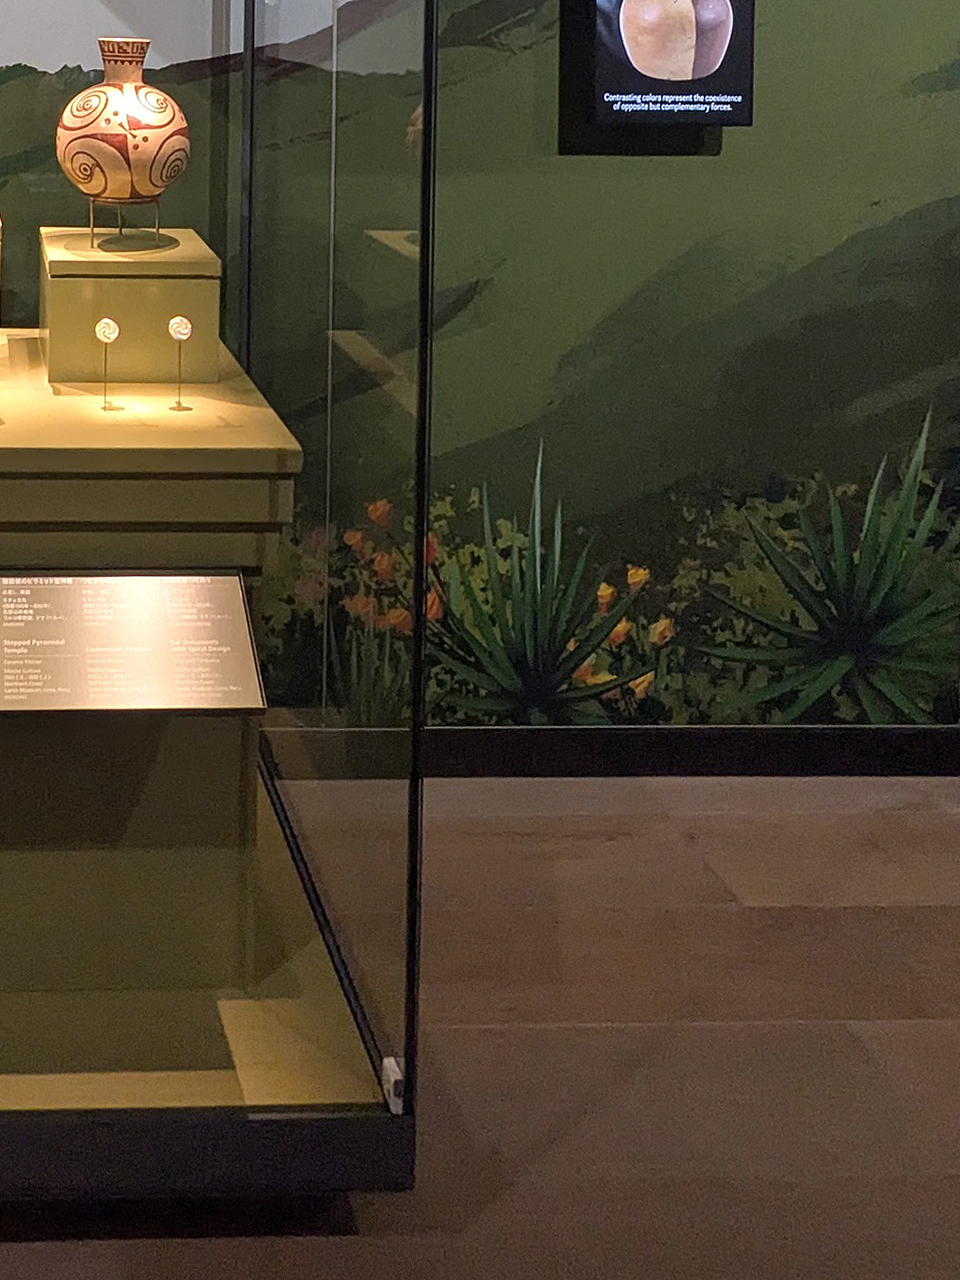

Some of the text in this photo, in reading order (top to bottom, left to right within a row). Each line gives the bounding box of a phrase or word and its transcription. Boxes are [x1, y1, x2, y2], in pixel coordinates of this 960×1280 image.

[603, 92, 742, 103] Contrasting colors represent the coexistence
[613, 102, 732, 113] of opposite but complementary forces.
[3, 639, 31, 647] Stepped
